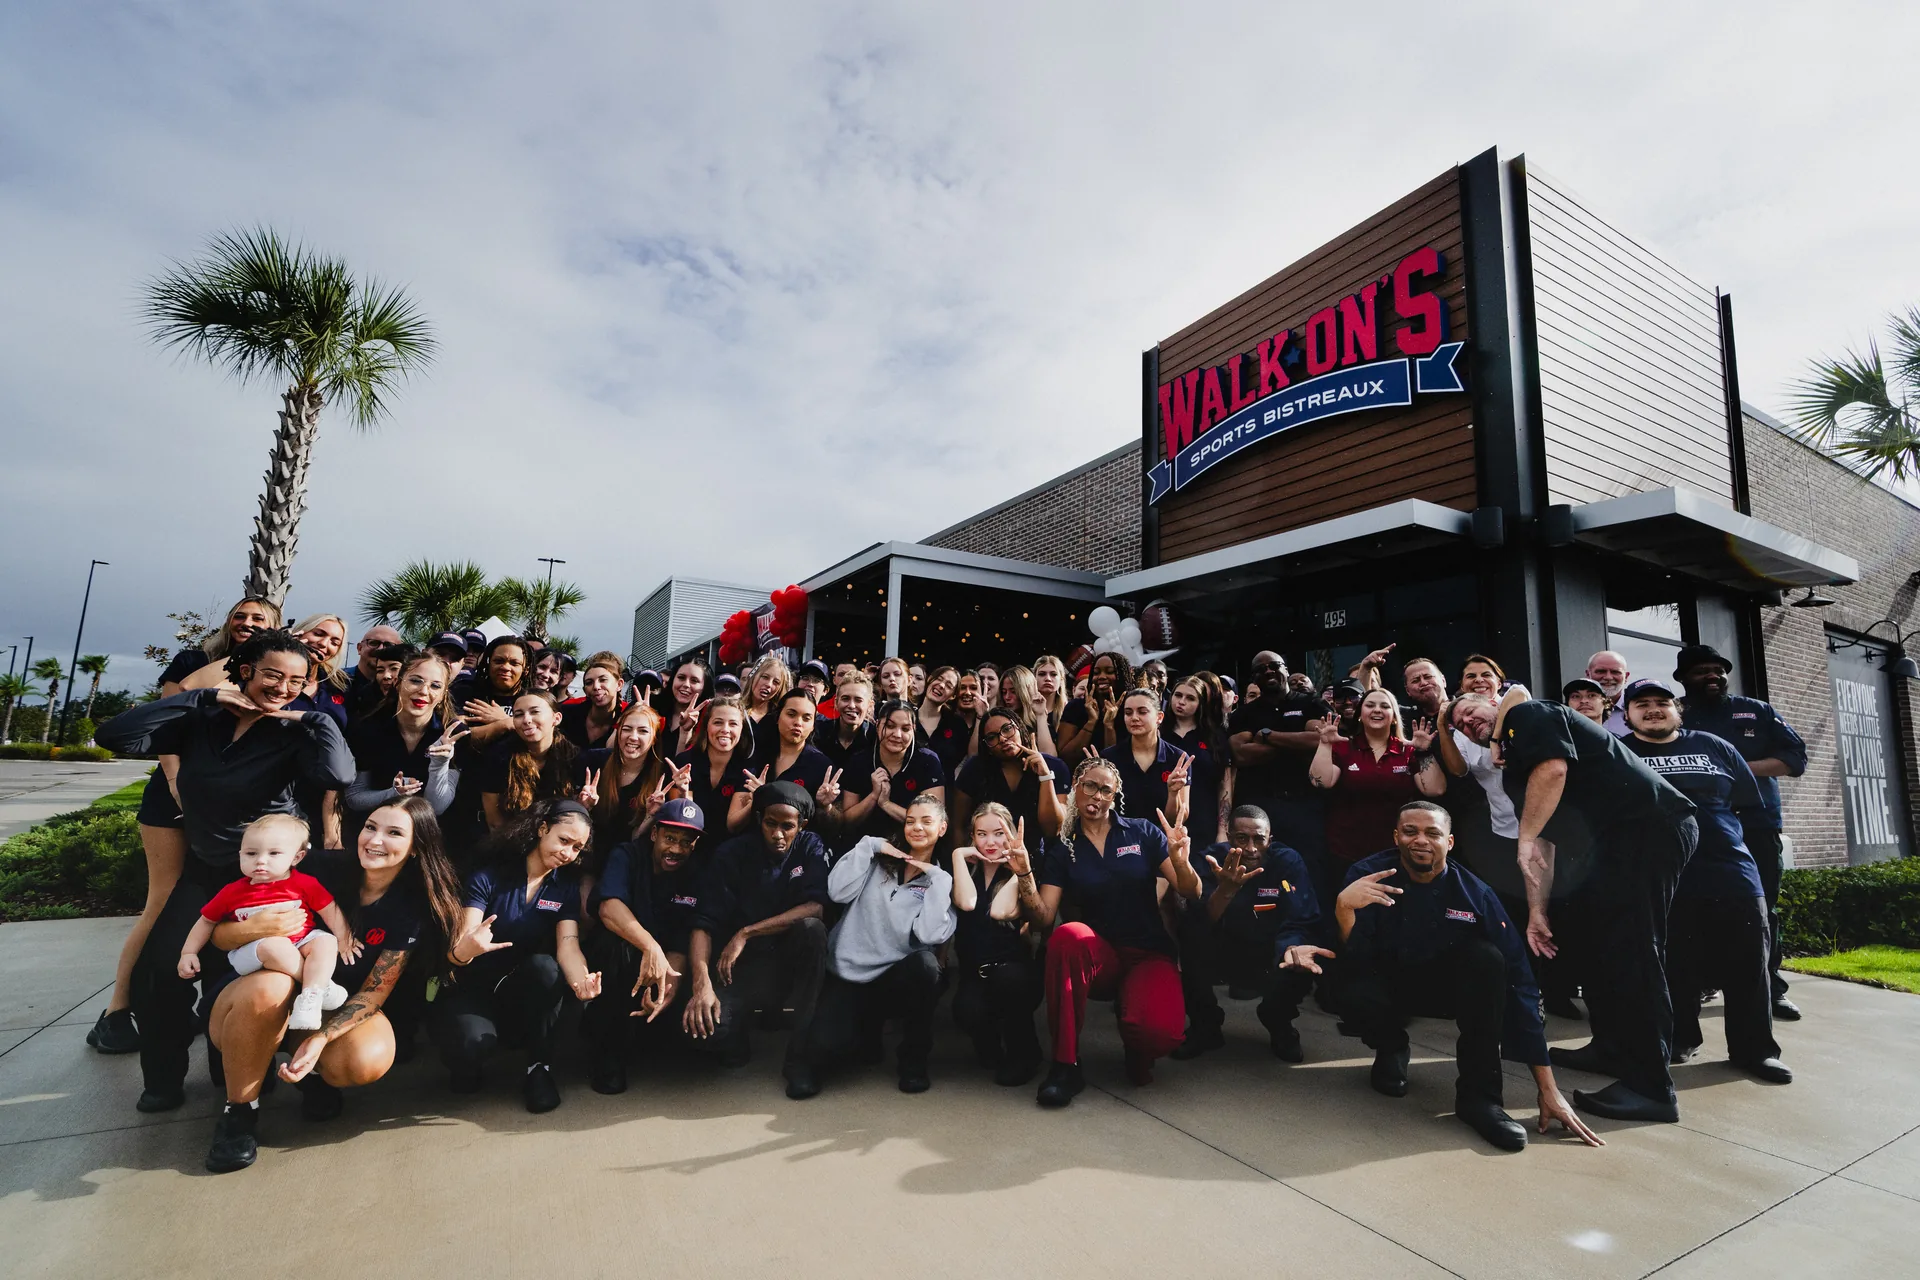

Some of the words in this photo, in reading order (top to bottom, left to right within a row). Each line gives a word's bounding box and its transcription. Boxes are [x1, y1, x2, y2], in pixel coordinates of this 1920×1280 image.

[1190, 419, 1256, 468] SPORTS
[1263, 379, 1384, 426] BISTREAUX
[1325, 610, 1345, 628] 495
[1835, 678, 1879, 717] EVERYONE
[1839, 711, 1859, 735] NEEDS
[1858, 715, 1864, 736] A
[1863, 716, 1881, 739] LITTLE
[1841, 735, 1886, 778] PLAYING
[1846, 776, 1895, 845] TIME
